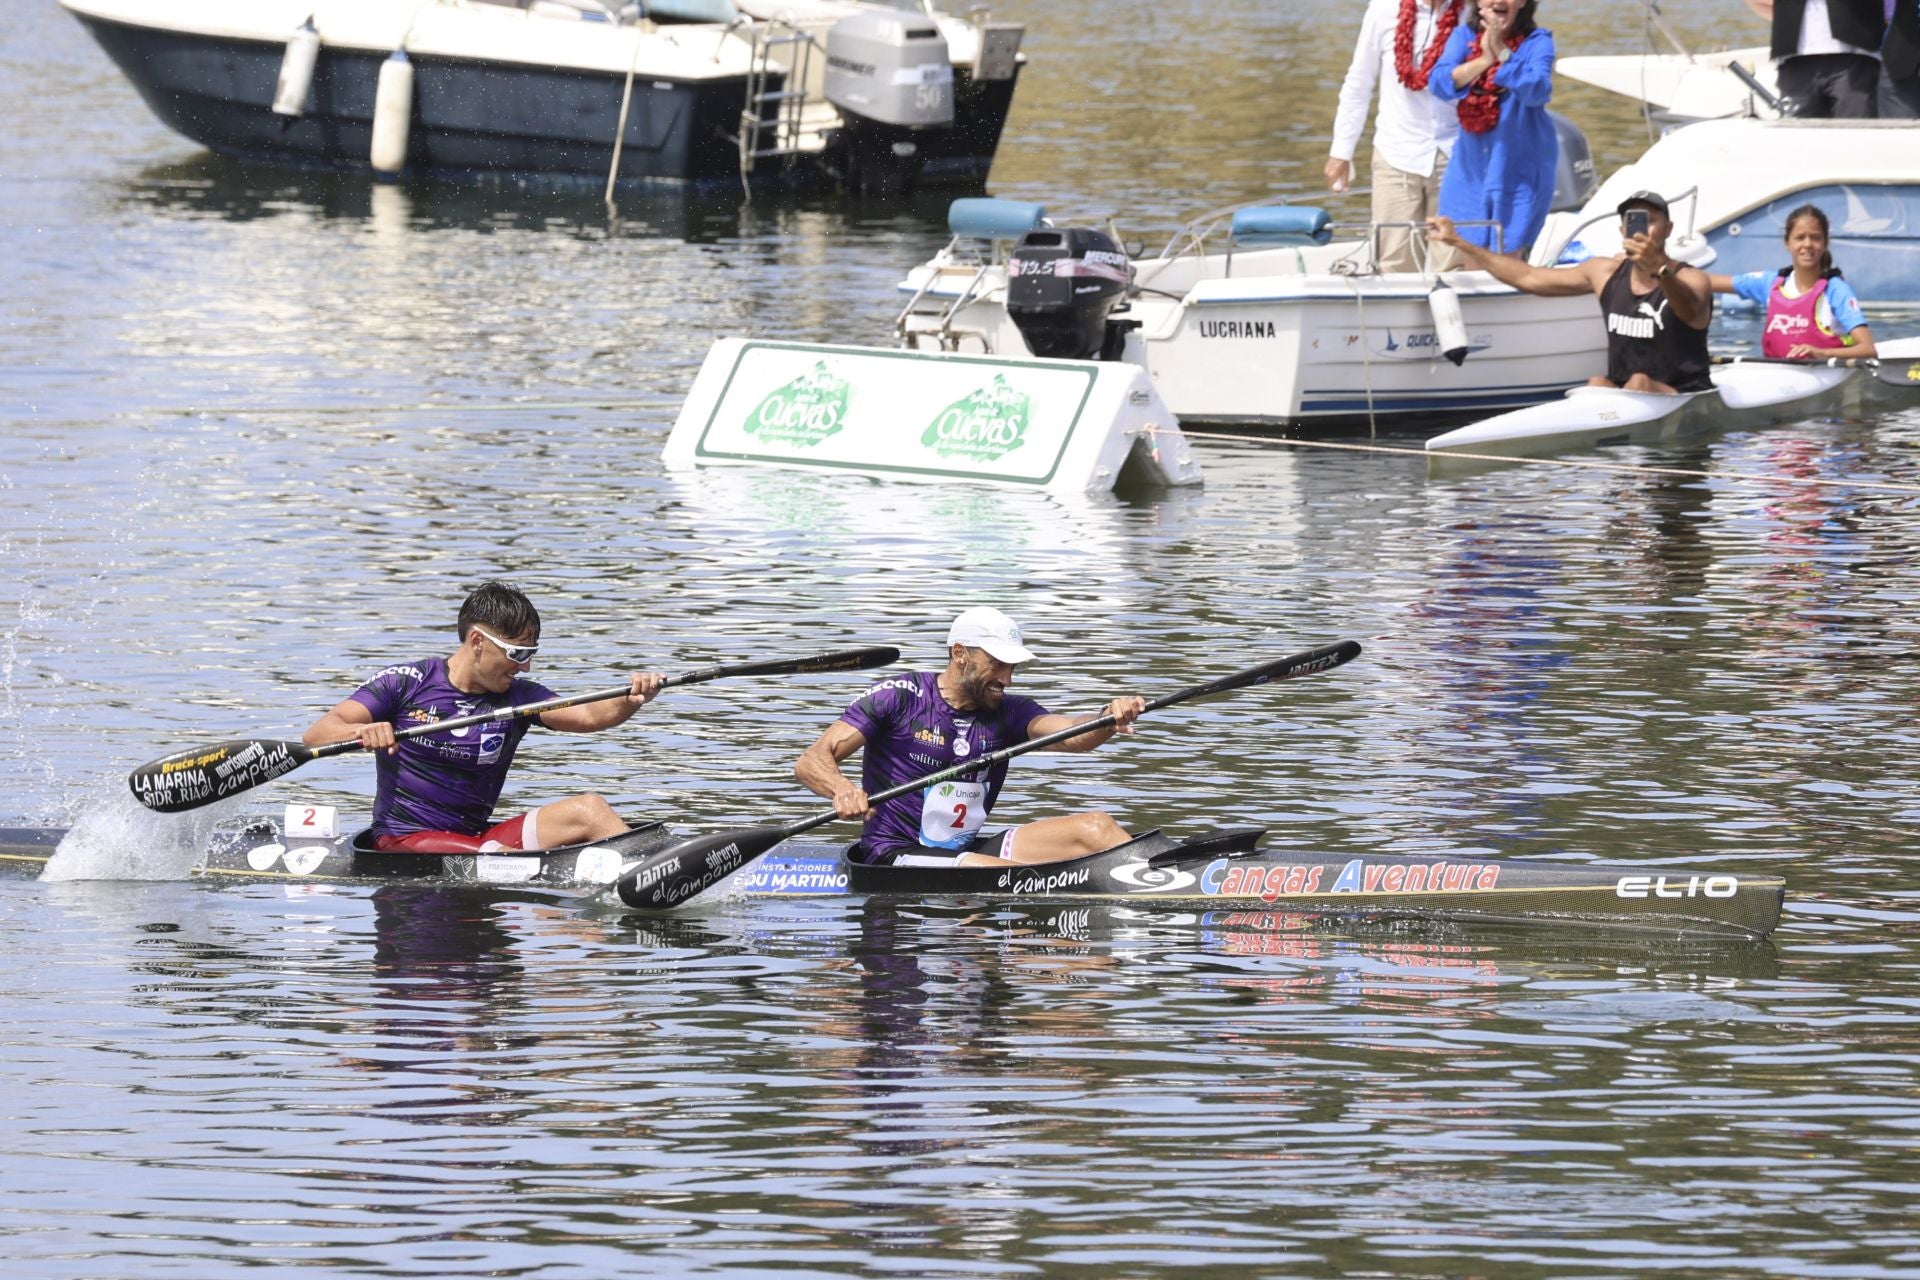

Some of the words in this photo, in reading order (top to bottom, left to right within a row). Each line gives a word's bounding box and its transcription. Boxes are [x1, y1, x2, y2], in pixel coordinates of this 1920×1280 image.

[915, 84, 941, 110] 50
[1200, 321, 1276, 338] LUCRIANA
[1608, 312, 1654, 338] PUMA
[759, 394, 842, 431] Cuevas
[937, 408, 1023, 445] Cuevas
[134, 774, 152, 793] LA
[153, 768, 208, 787] MARINA
[217, 743, 288, 797] campanu
[143, 787, 202, 808] SIDRRIA
[302, 808, 316, 826] 2
[950, 803, 967, 829] 2
[757, 863, 834, 873] INSTALACIONES
[771, 873, 849, 889] MARTINO
[1200, 858, 1324, 903] Cangas
[1331, 859, 1502, 893] Aventura
[998, 868, 1012, 887] el
[1013, 868, 1090, 895] campanu
[1616, 876, 1739, 898] ELIO
